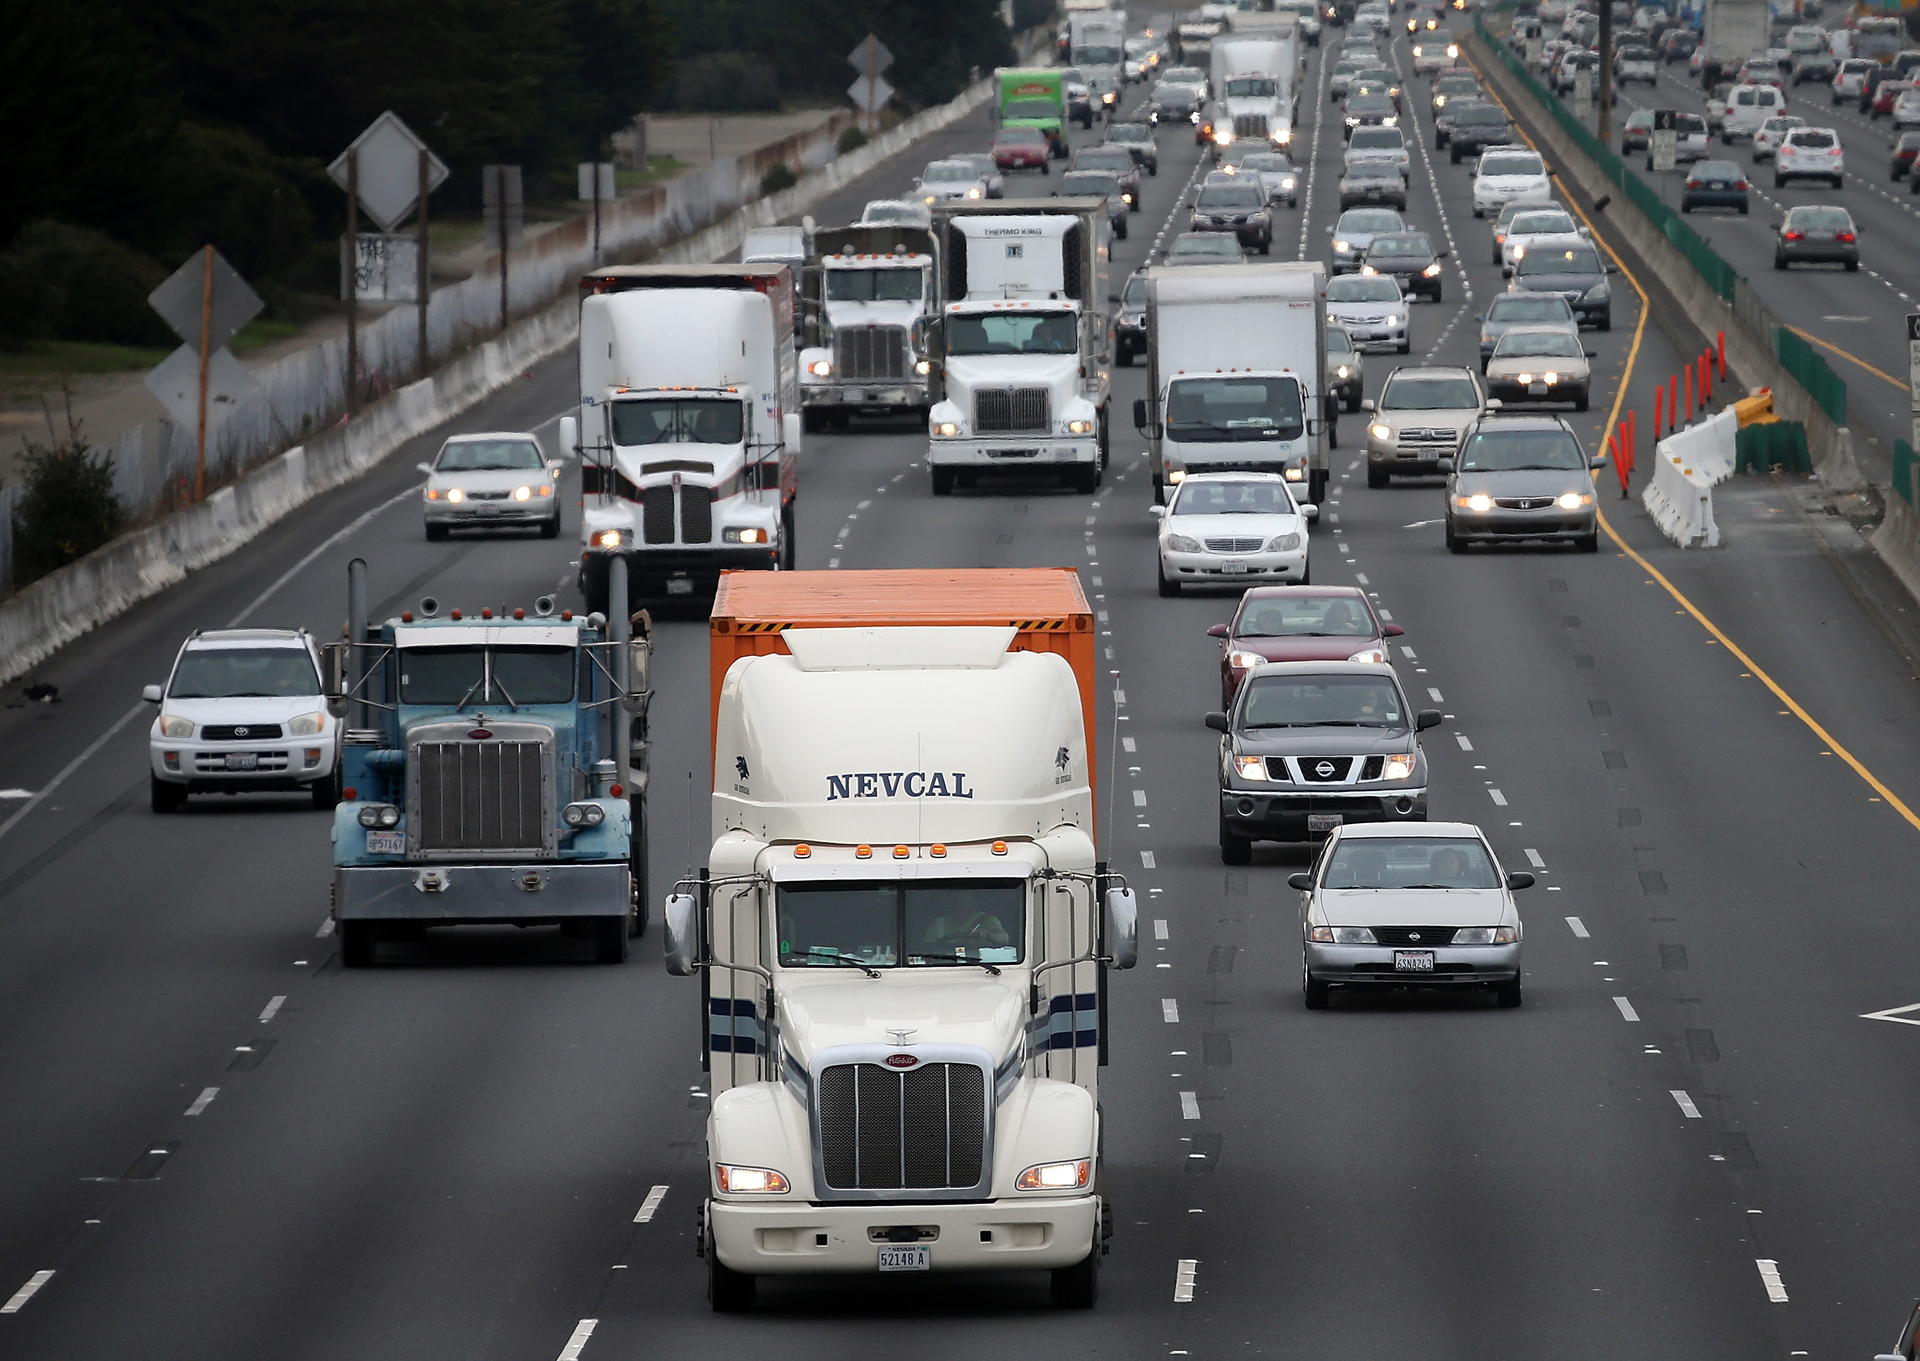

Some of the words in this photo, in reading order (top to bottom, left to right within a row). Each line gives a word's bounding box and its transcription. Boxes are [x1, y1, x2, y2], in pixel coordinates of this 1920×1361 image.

[984, 228, 1020, 236] THERMO
[1021, 227, 1042, 235] KING
[826, 771, 974, 801] NEVCAL
[1397, 958, 1433, 969] 6SNA243
[880, 1252, 914, 1266] 52148
[918, 1252, 924, 1265] A
